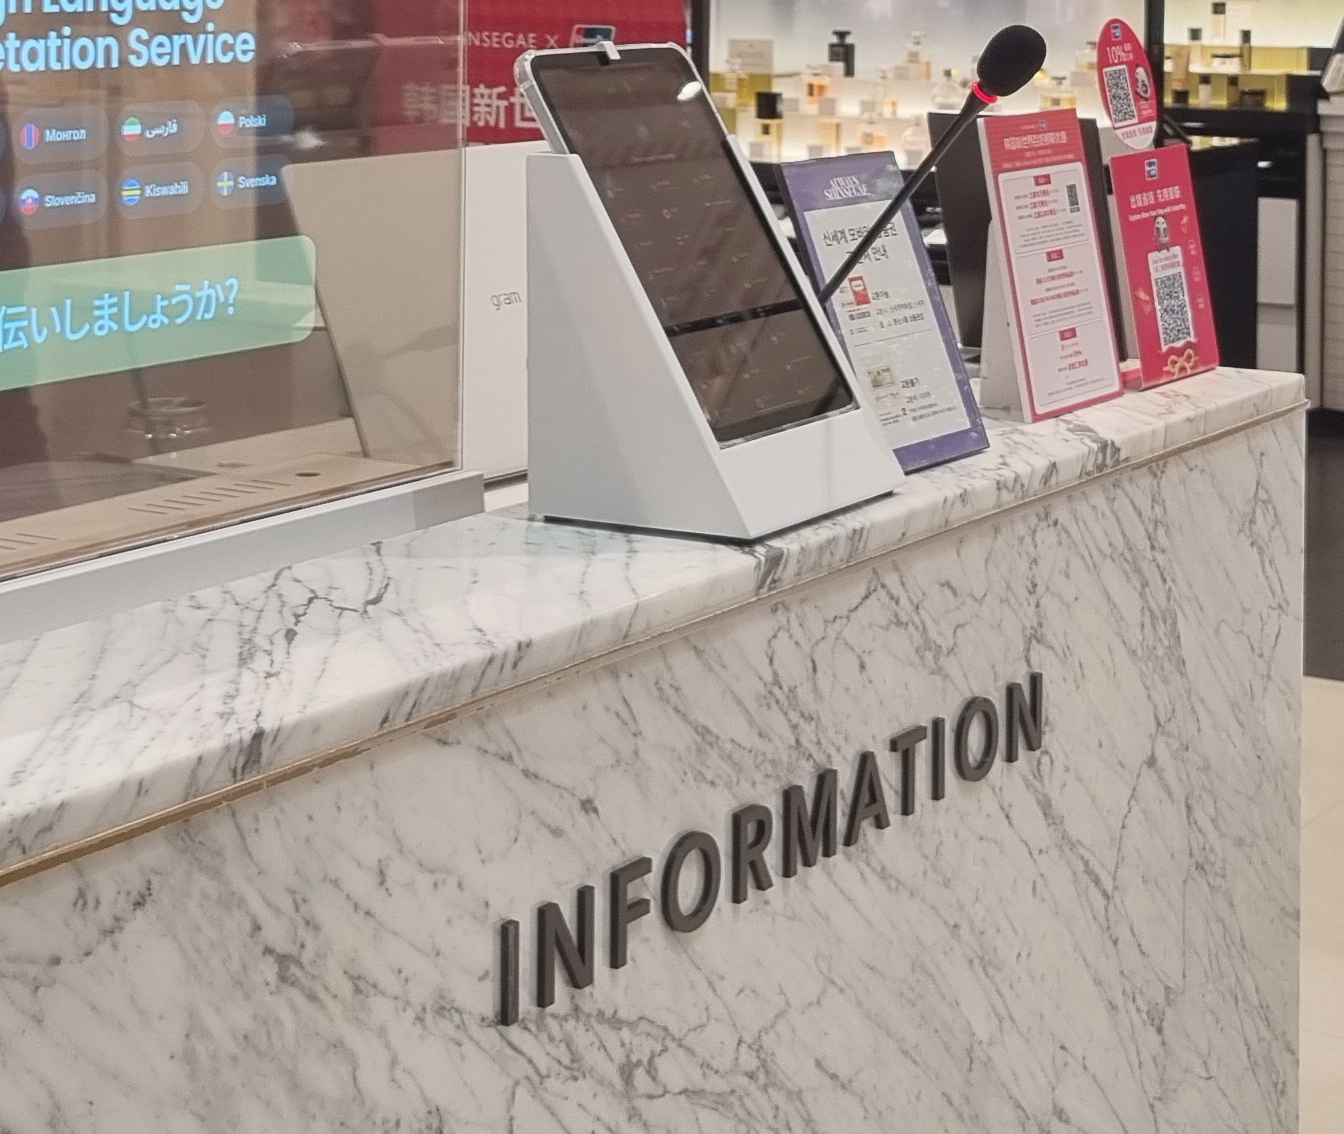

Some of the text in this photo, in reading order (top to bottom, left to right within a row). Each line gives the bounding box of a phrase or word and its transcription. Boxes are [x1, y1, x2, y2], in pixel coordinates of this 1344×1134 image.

[129, 26, 256, 68] Service
[238, 114, 267, 128] Polski
[45, 128, 87, 143] Монгол
[238, 173, 277, 188] Svenska
[145, 181, 189, 198] Kiswahili
[45, 191, 96, 208] Slovenčina
[490, 290, 523, 311] gram
[499, 670, 1045, 1028] INFORMATION
